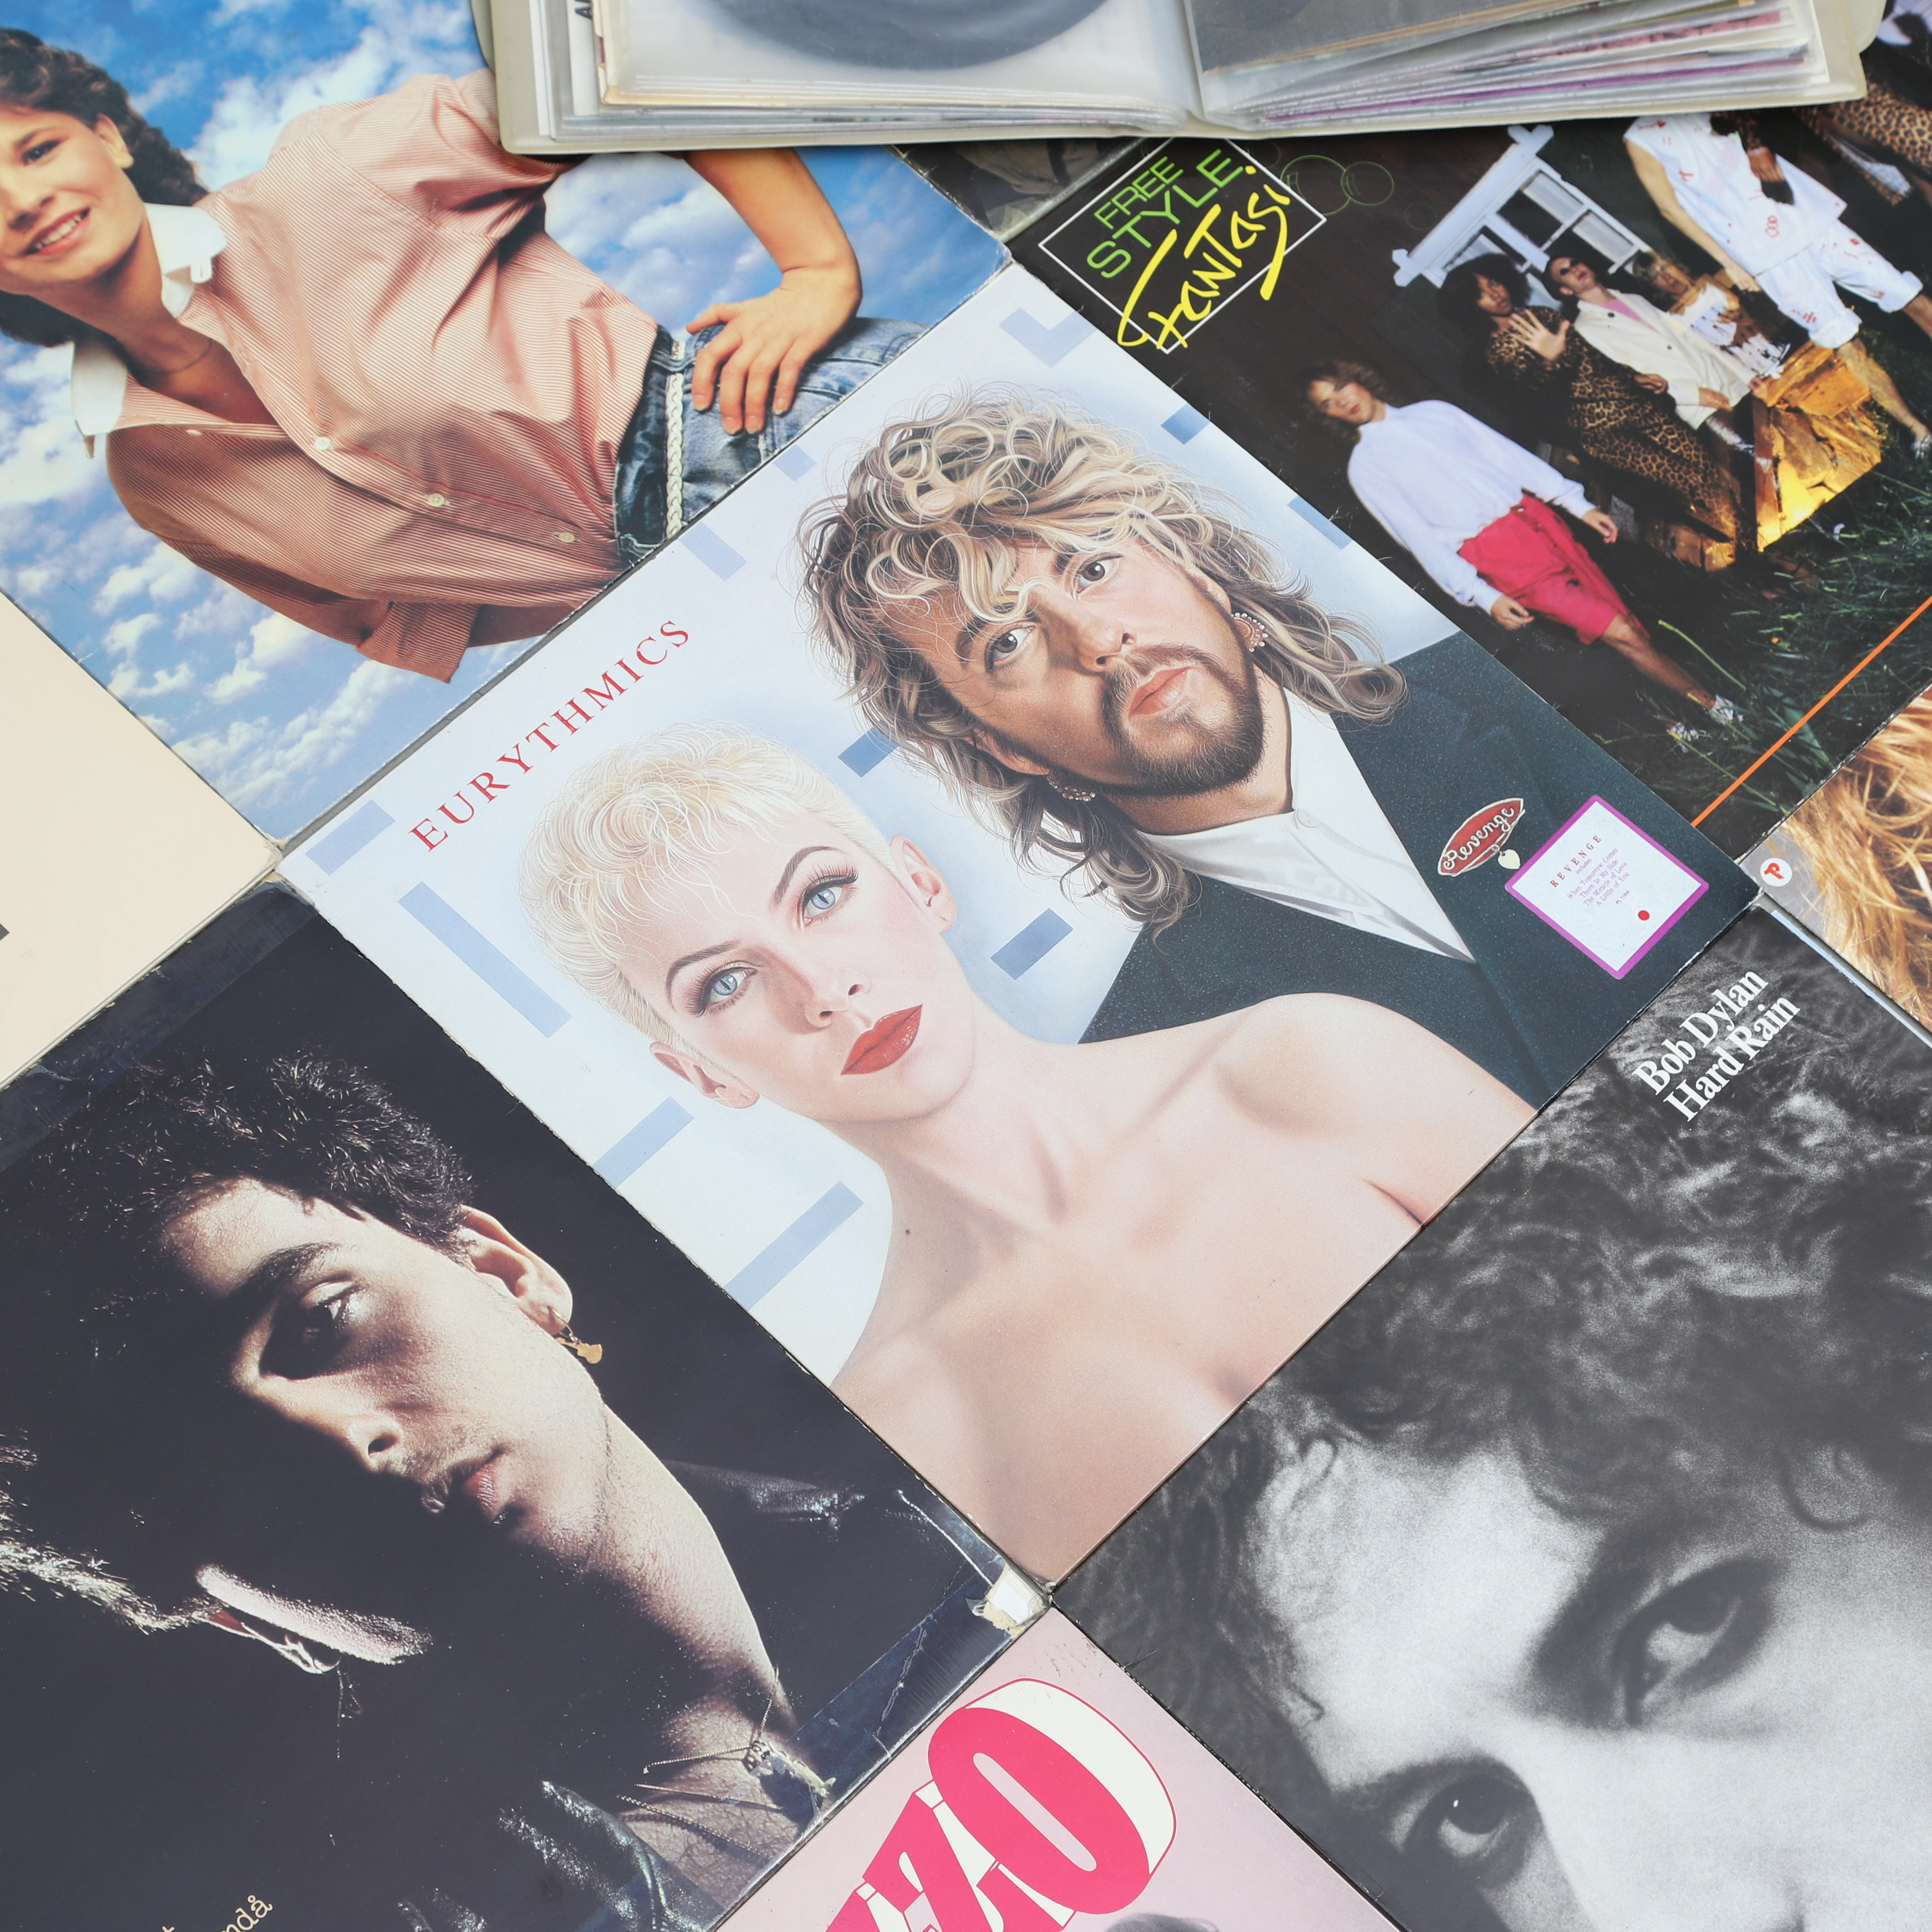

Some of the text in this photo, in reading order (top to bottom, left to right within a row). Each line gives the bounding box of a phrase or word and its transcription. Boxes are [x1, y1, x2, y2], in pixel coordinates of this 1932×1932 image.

[1094, 156, 1183, 229] FREE
[408, 620, 689, 852] EURYTHMICS
[1443, 808, 1514, 870] Revenge
[1549, 835, 1601, 888] REVENGE
[1566, 848, 1619, 899] When Tomorrow Comes
[1575, 859, 1592, 874] includes
[1580, 884, 1595, 898] Thorn
[1599, 869, 1609, 878] My
[1606, 859, 1619, 870] Side
[1583, 896, 1595, 906] The
[1593, 879, 1611, 897] Miracle
[1615, 862, 1628, 874] Love
[1600, 888, 1614, 901] Little
[1618, 872, 1630, 882] You
[1632, 971, 1769, 1095] Bob Dylan
[1663, 998, 1801, 1122] Hard Rain
